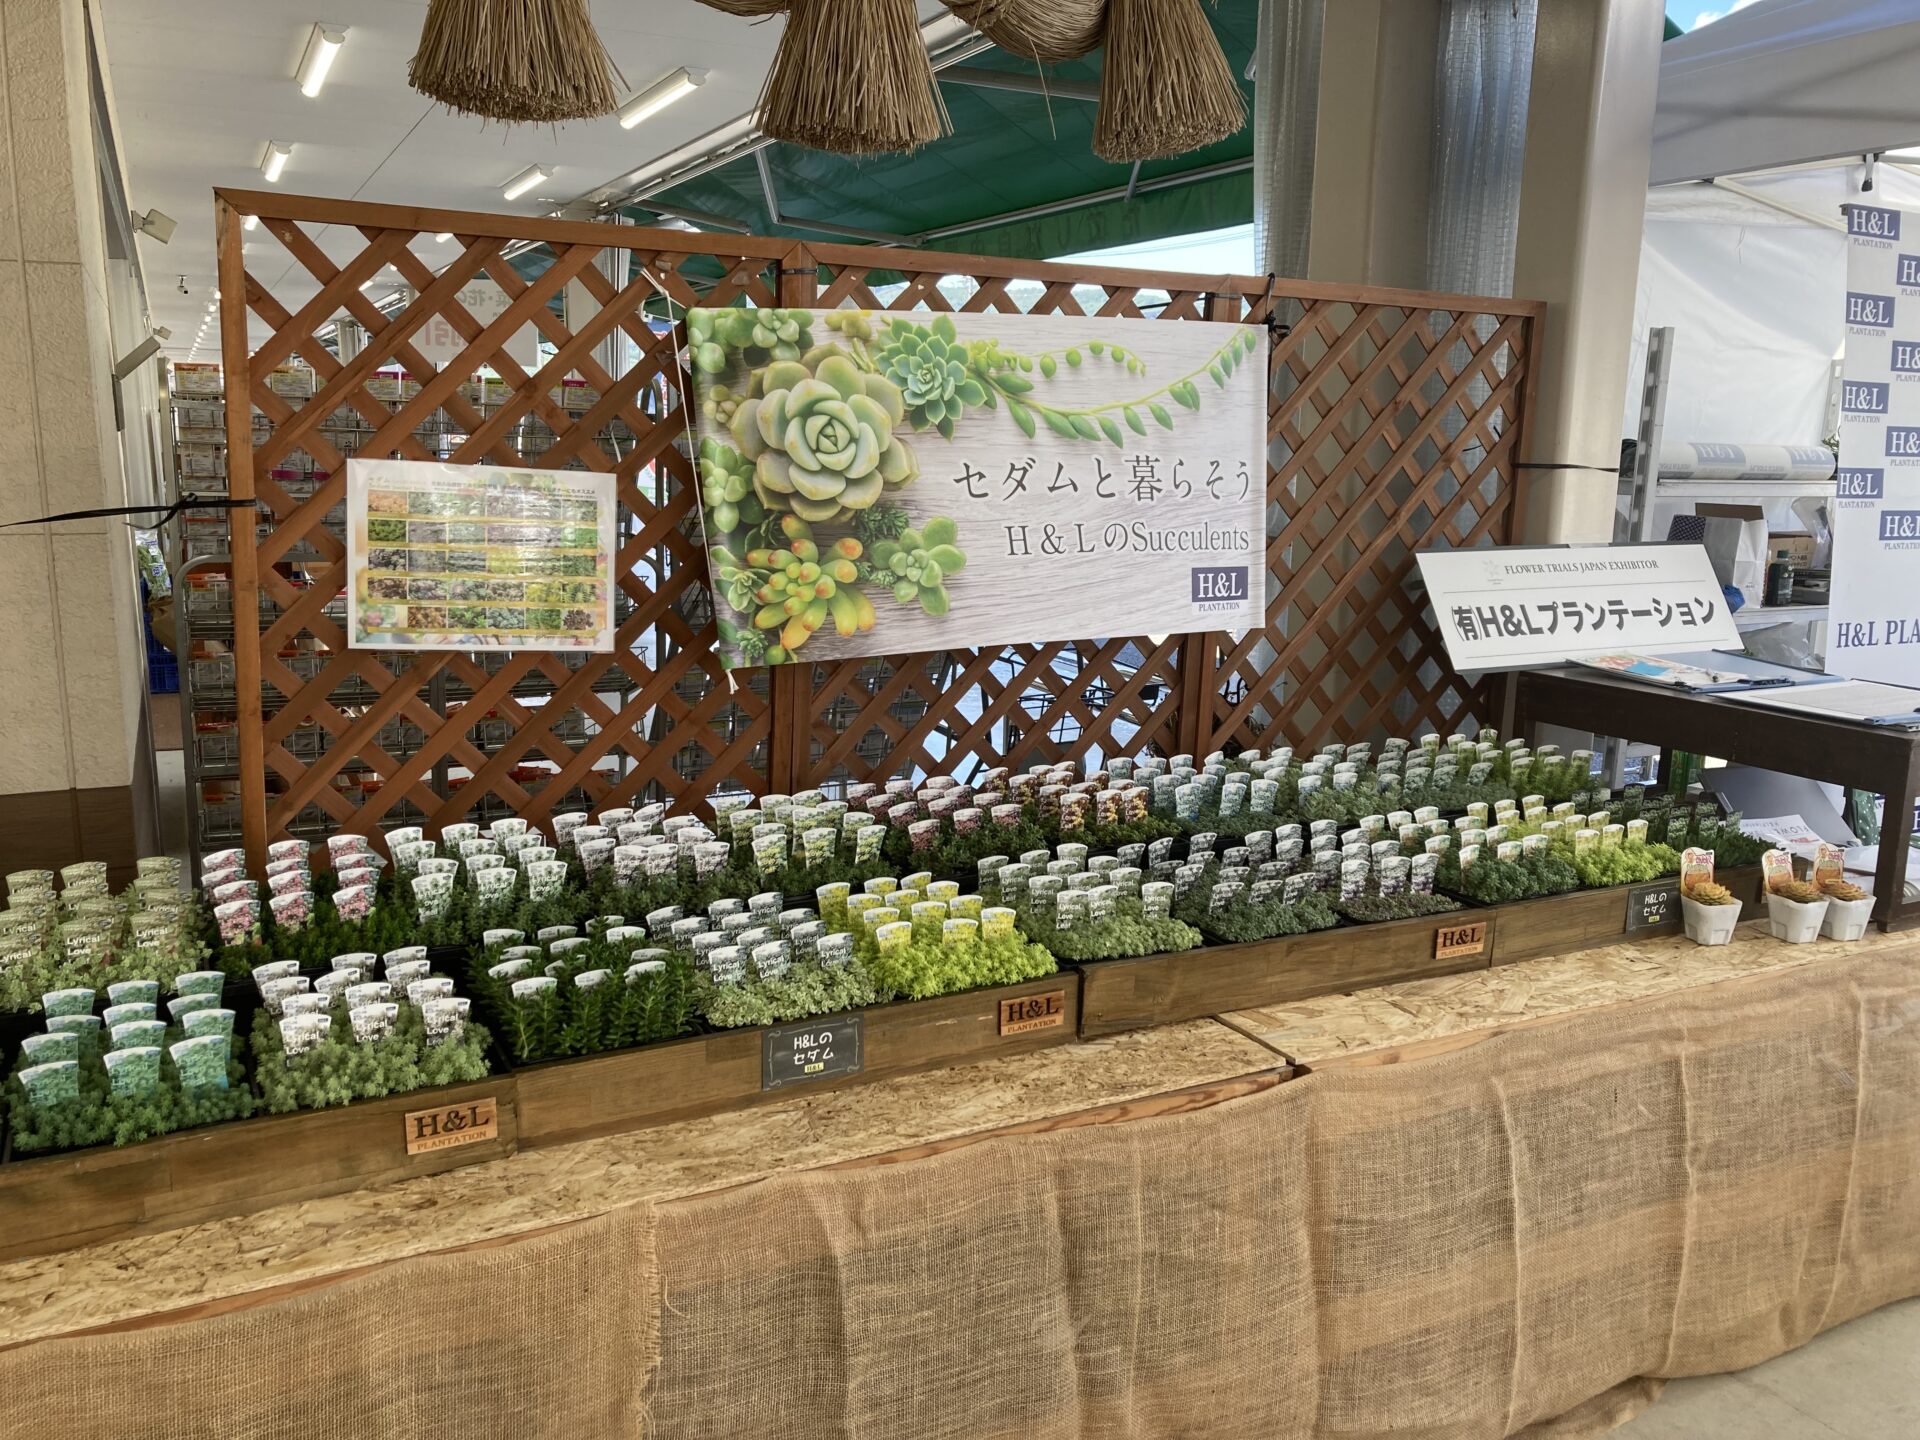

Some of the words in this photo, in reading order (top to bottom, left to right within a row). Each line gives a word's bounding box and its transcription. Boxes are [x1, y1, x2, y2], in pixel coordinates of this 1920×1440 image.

[1852, 208, 1896, 236] H&L
[1853, 237, 1893, 249] PLANTATION
[1849, 297, 1890, 324] H&L
[1849, 326, 1886, 337] PLANTATION
[1844, 386, 1884, 410] H&L
[1844, 414, 1880, 423] PLANTATION
[952, 454, 1251, 502] セダムと暮らそう
[1839, 473, 1878, 495] H&L
[1504, 564, 1544, 575] FLOWER
[1545, 562, 1579, 573] TRIALS
[1579, 562, 1608, 573] JAPAN
[1608, 560, 1660, 571] EXHIBITOR
[1197, 572, 1243, 598] H&L
[1198, 602, 1240, 611] PLANTATION
[1836, 621, 1879, 648] H&L
[1032, 888, 1054, 897] Lyrical
[1145, 894, 1166, 903] Lyrical
[1644, 892, 1667, 905] H&Lの
[1060, 903, 1081, 911] Lyrical
[1091, 909, 1106, 917] Love
[137, 928, 168, 938] Lyrical
[1442, 927, 1481, 948] H&L
[67, 935, 100, 946] Lyrical
[137, 940, 160, 948] Love
[796, 934, 819, 946] Lyrical
[67, 947, 91, 956] Love
[821, 947, 847, 958] Lyrical
[713, 961, 740, 972] Lyrical
[758, 955, 785, 968] Lyrical
[713, 974, 732, 983] Love
[760, 969, 778, 979] Love
[1006, 997, 1059, 1022] H&L
[427, 1026, 449, 1035] Love
[1007, 1018, 1057, 1033] PLANTATION
[356, 1033, 379, 1043] Love
[793, 1031, 833, 1050] H&Lの
[286, 1046, 310, 1055] Love
[793, 1047, 834, 1065] セダム
[413, 1105, 490, 1139] H&L
[417, 1130, 487, 1151] PLANTATION
